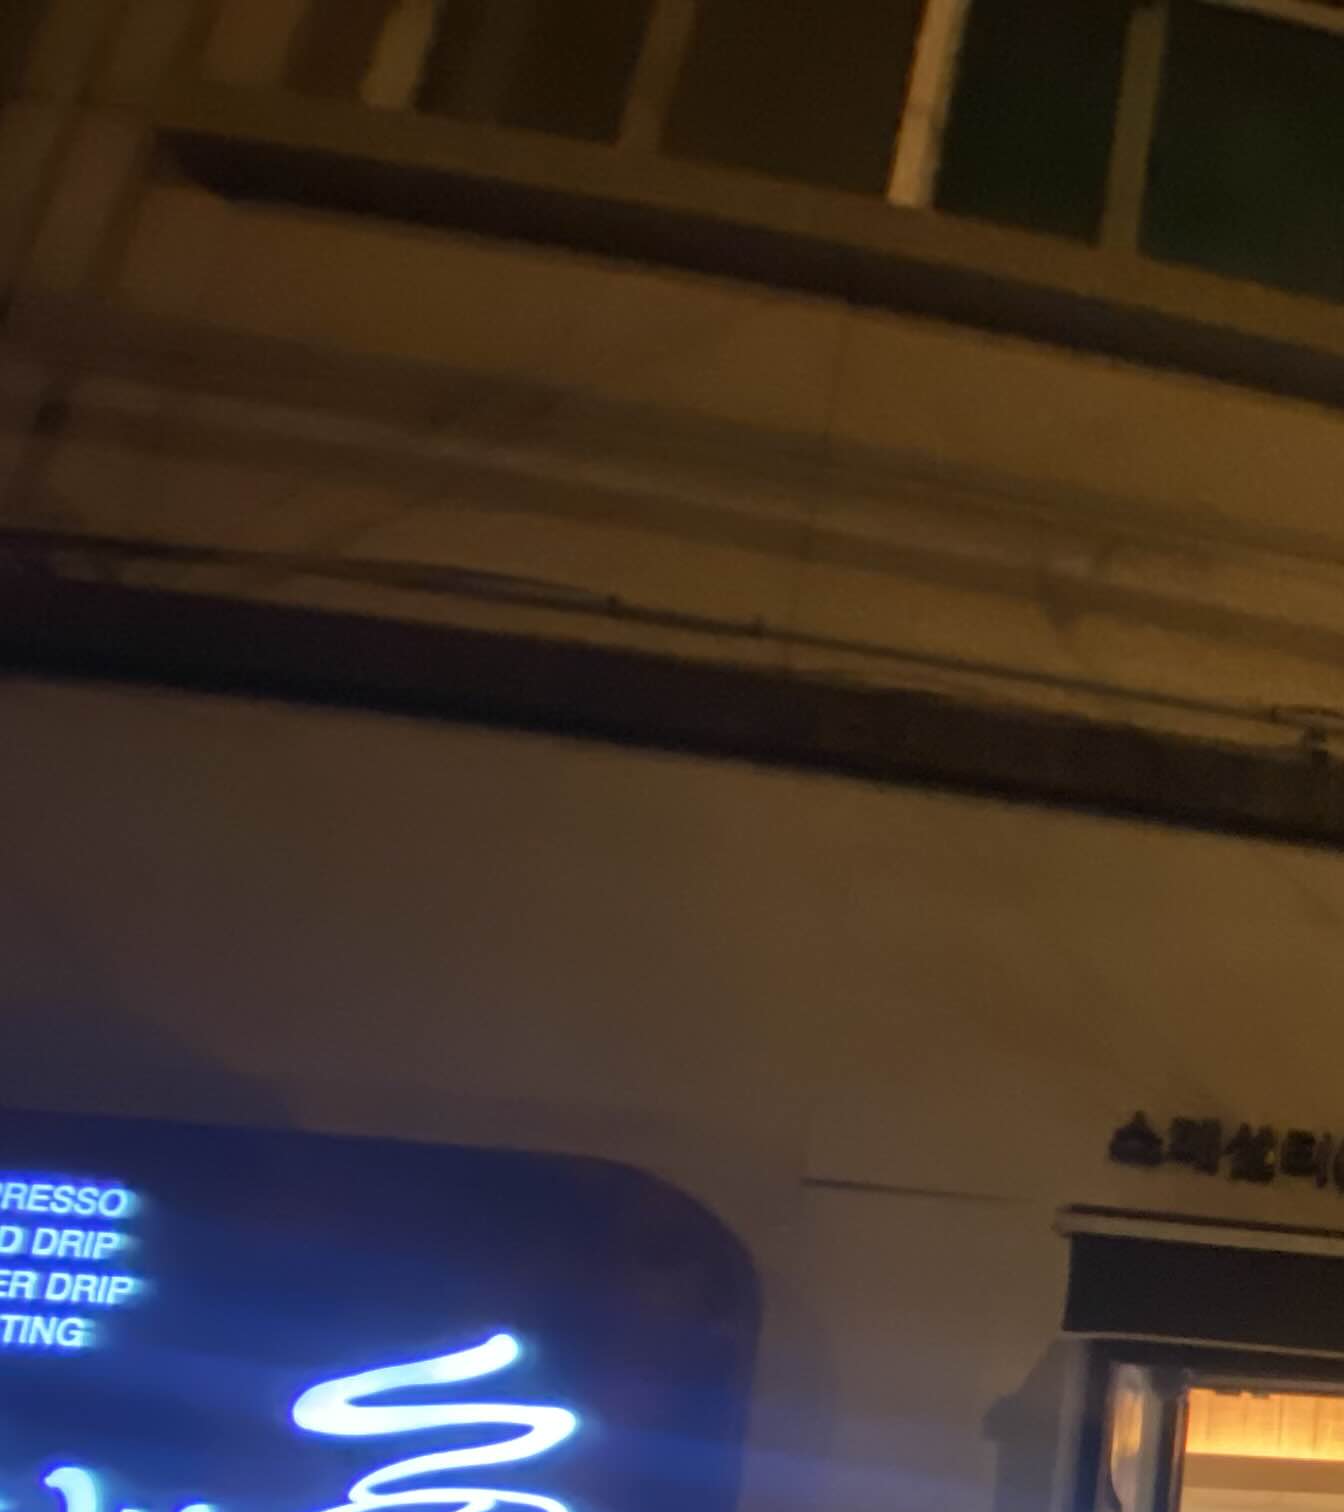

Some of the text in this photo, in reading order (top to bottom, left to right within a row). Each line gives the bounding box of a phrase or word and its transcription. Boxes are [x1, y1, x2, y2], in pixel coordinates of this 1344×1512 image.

[0, 1181, 128, 1218] RESSO
[32, 1227, 121, 1260] DRIP
[45, 1271, 134, 1305] DRIP
[0, 1314, 86, 1347] TING
